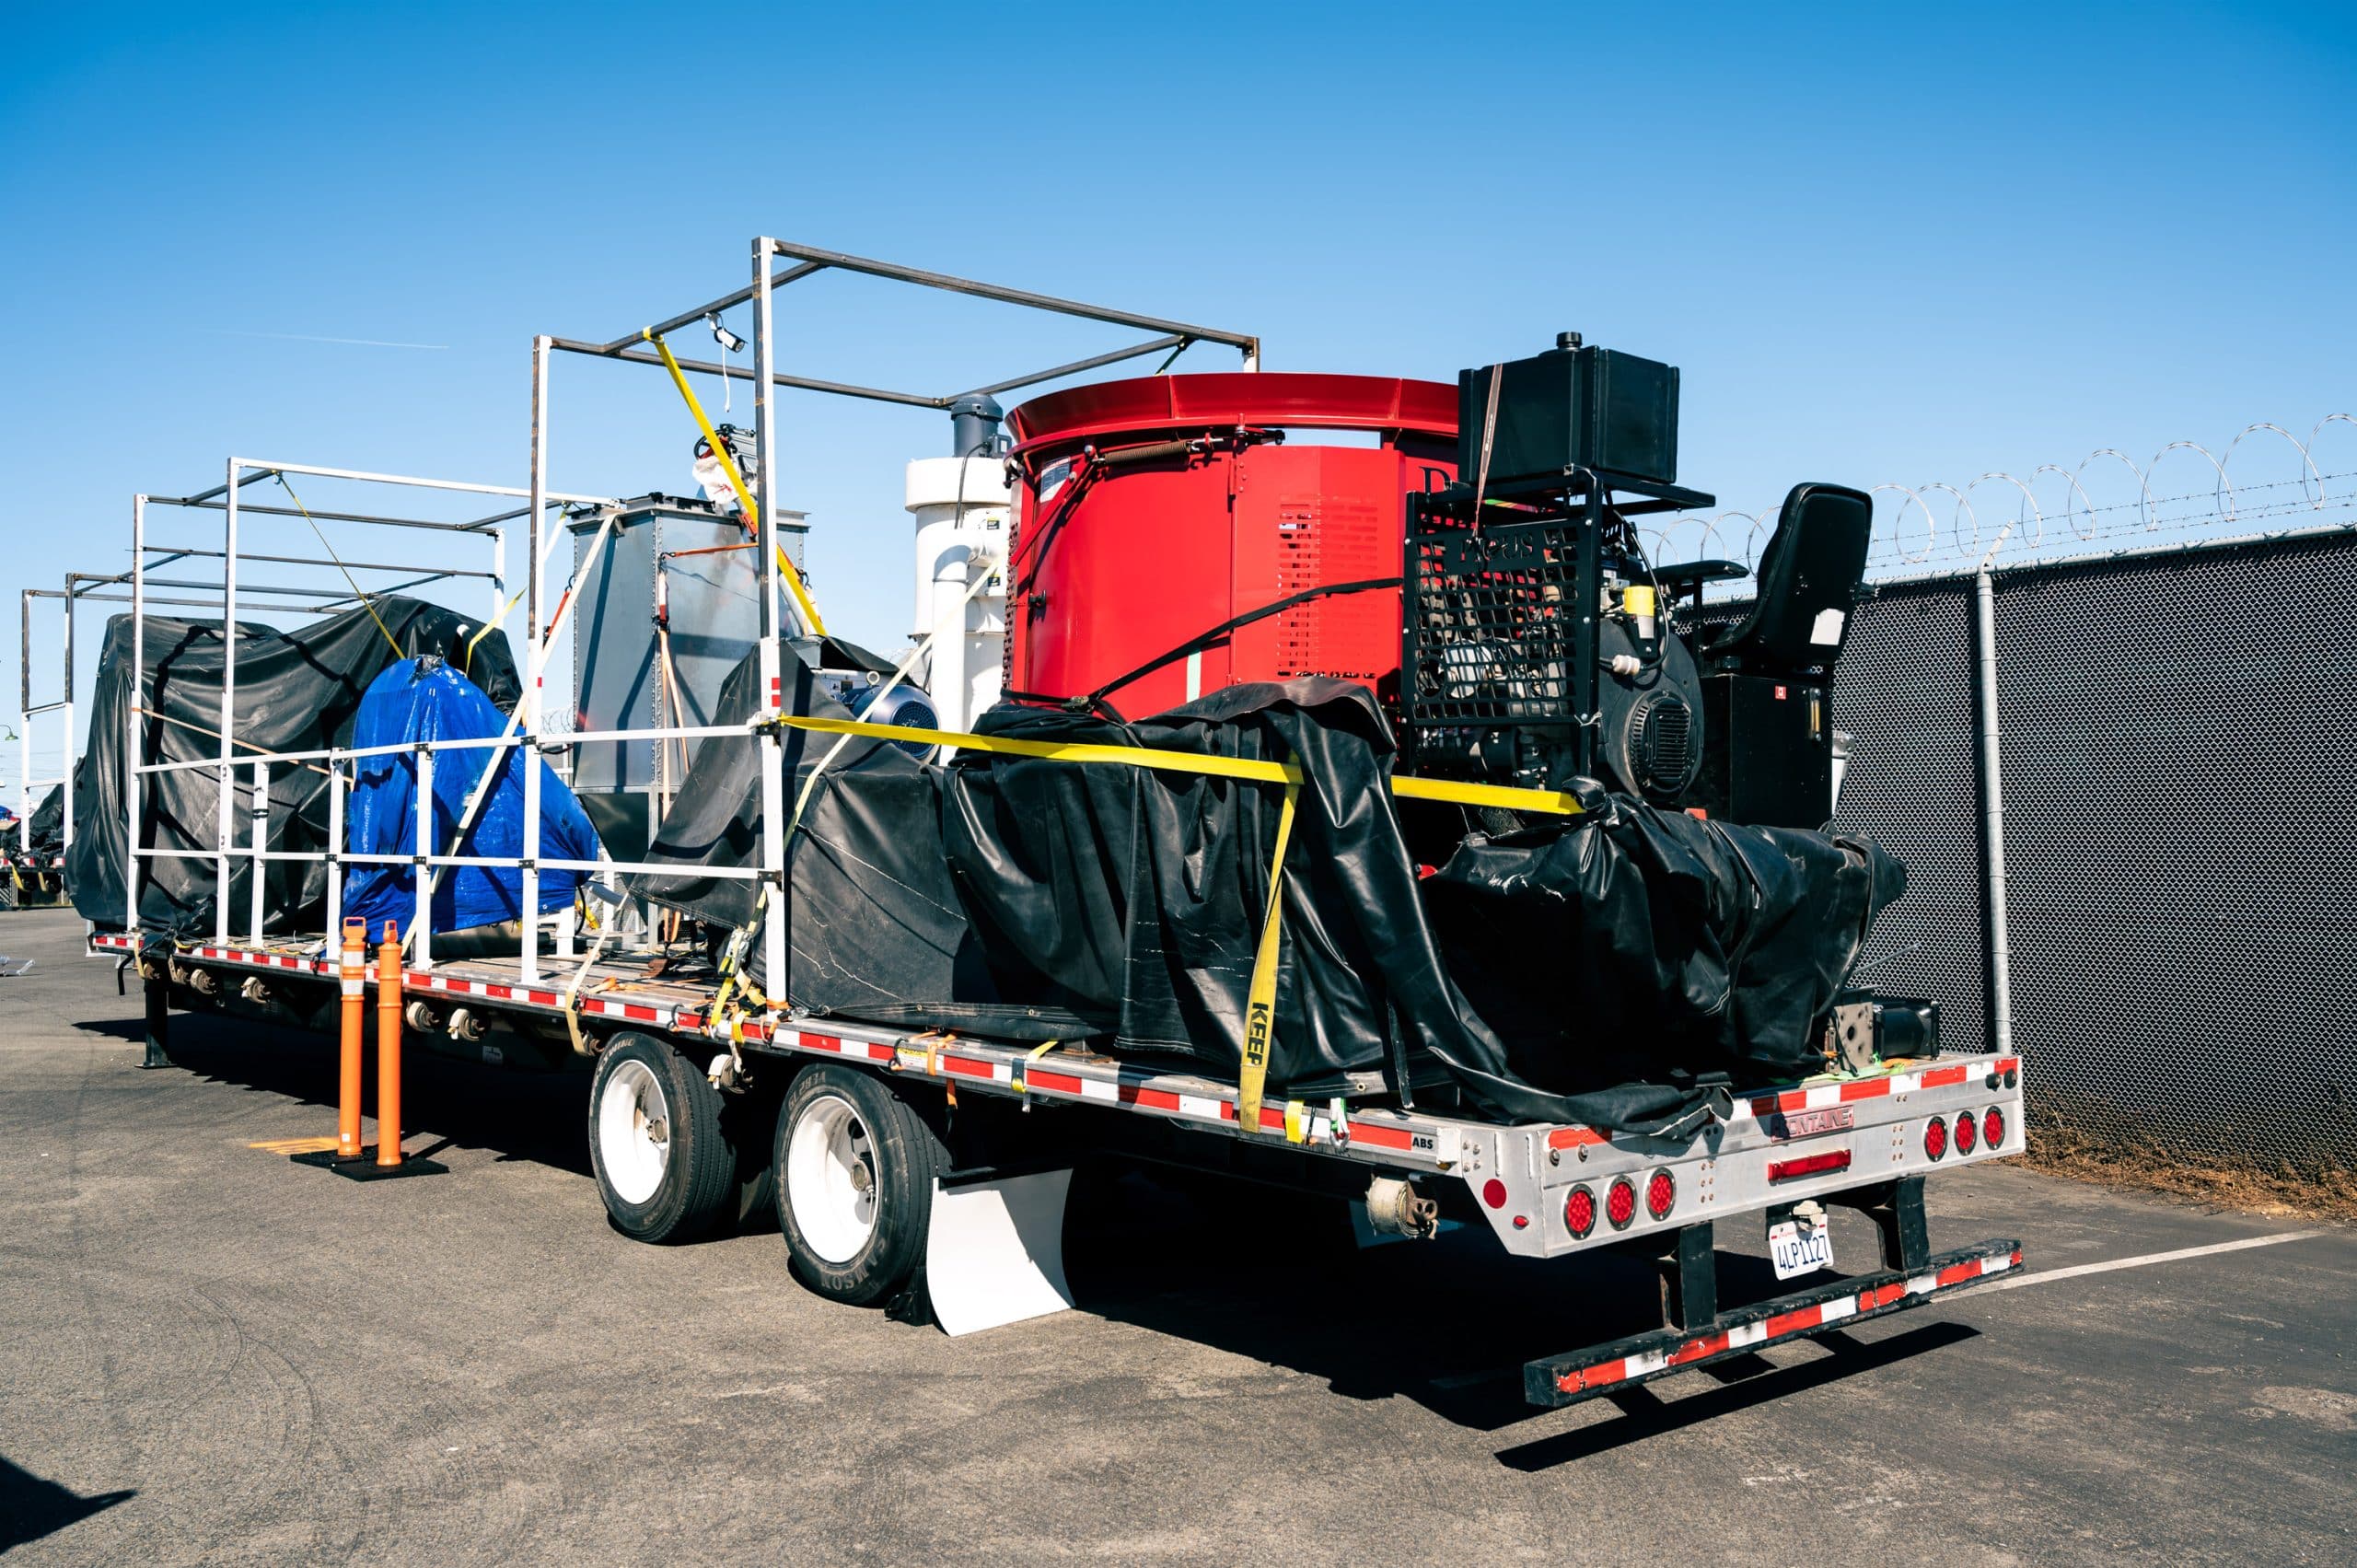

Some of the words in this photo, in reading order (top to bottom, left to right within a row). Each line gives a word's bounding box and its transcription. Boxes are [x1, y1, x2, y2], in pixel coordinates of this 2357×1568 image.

[1247, 1002, 1269, 1065] KEEP
[1778, 1108, 1850, 1139] ONTAINE
[1412, 1136, 1434, 1150] ABS
[1777, 1235, 1829, 1272] 4LP1127
